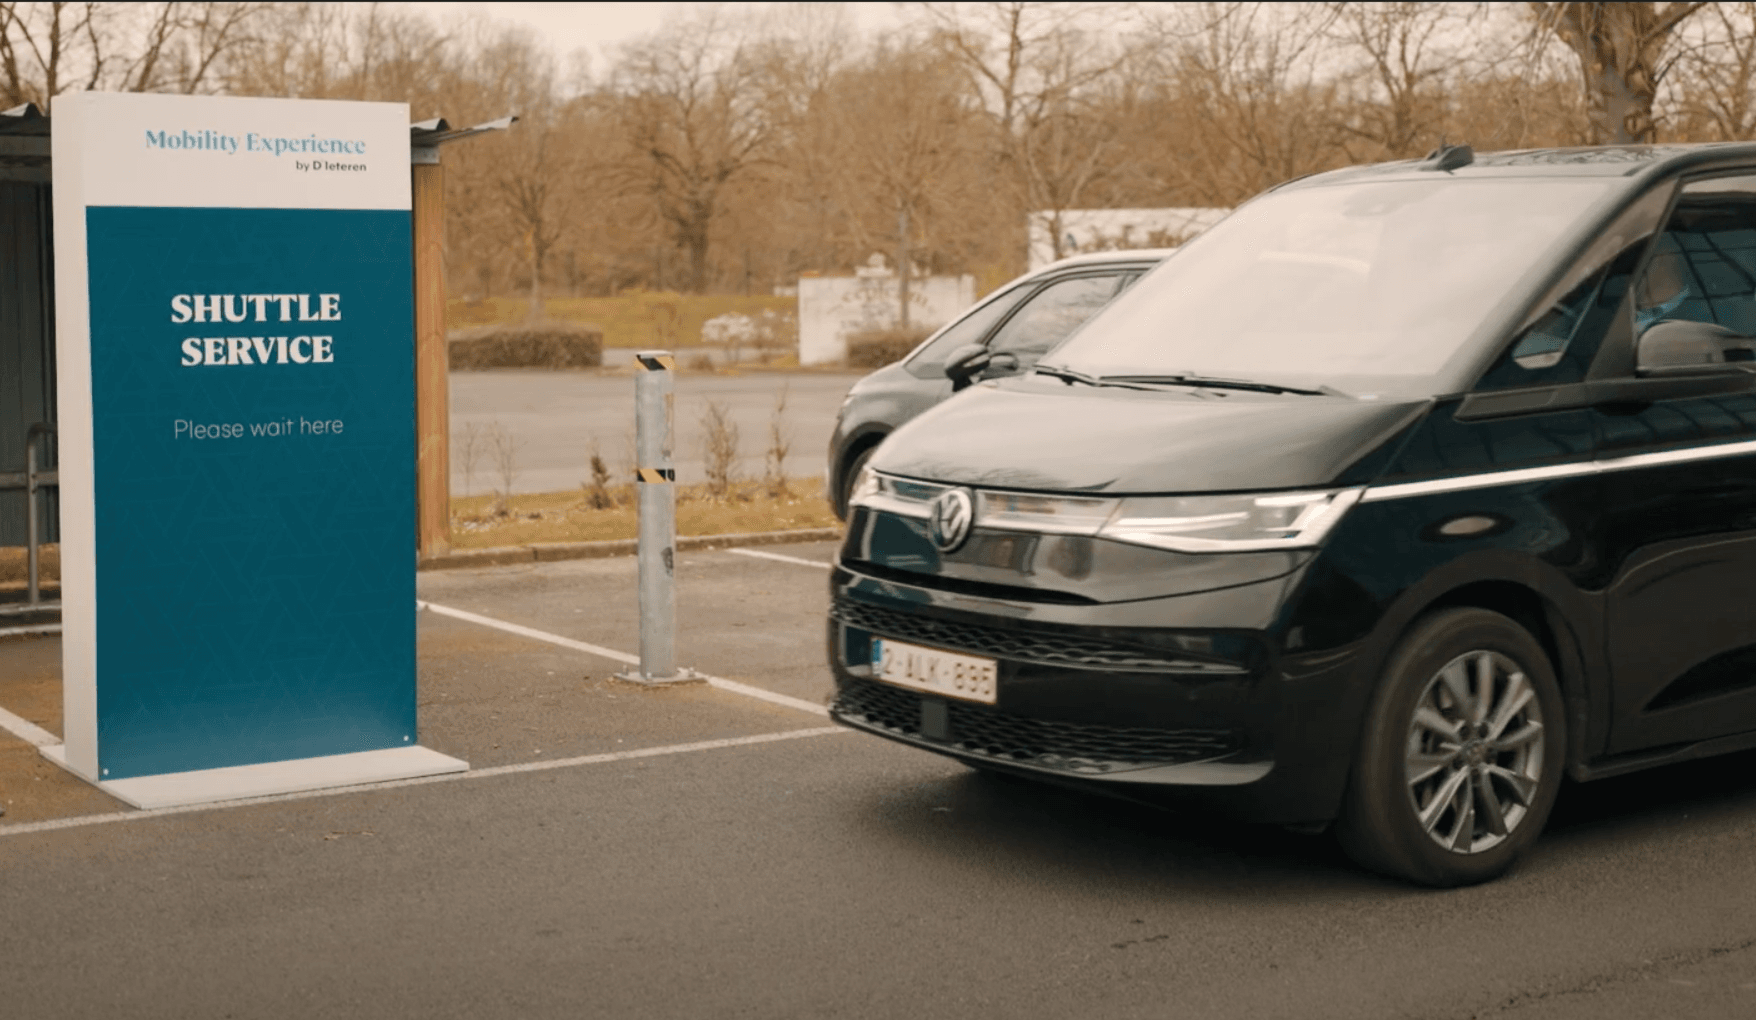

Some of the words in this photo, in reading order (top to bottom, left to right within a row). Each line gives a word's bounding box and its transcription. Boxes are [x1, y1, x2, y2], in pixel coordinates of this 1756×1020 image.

[145, 129, 238, 155] Mobility
[246, 132, 367, 157] Experience
[295, 160, 310, 173] by
[170, 293, 342, 323] SHUTTLE
[181, 335, 334, 367] SERVICE
[173, 418, 244, 440] Please
[249, 416, 294, 437] wait
[300, 415, 344, 435] here
